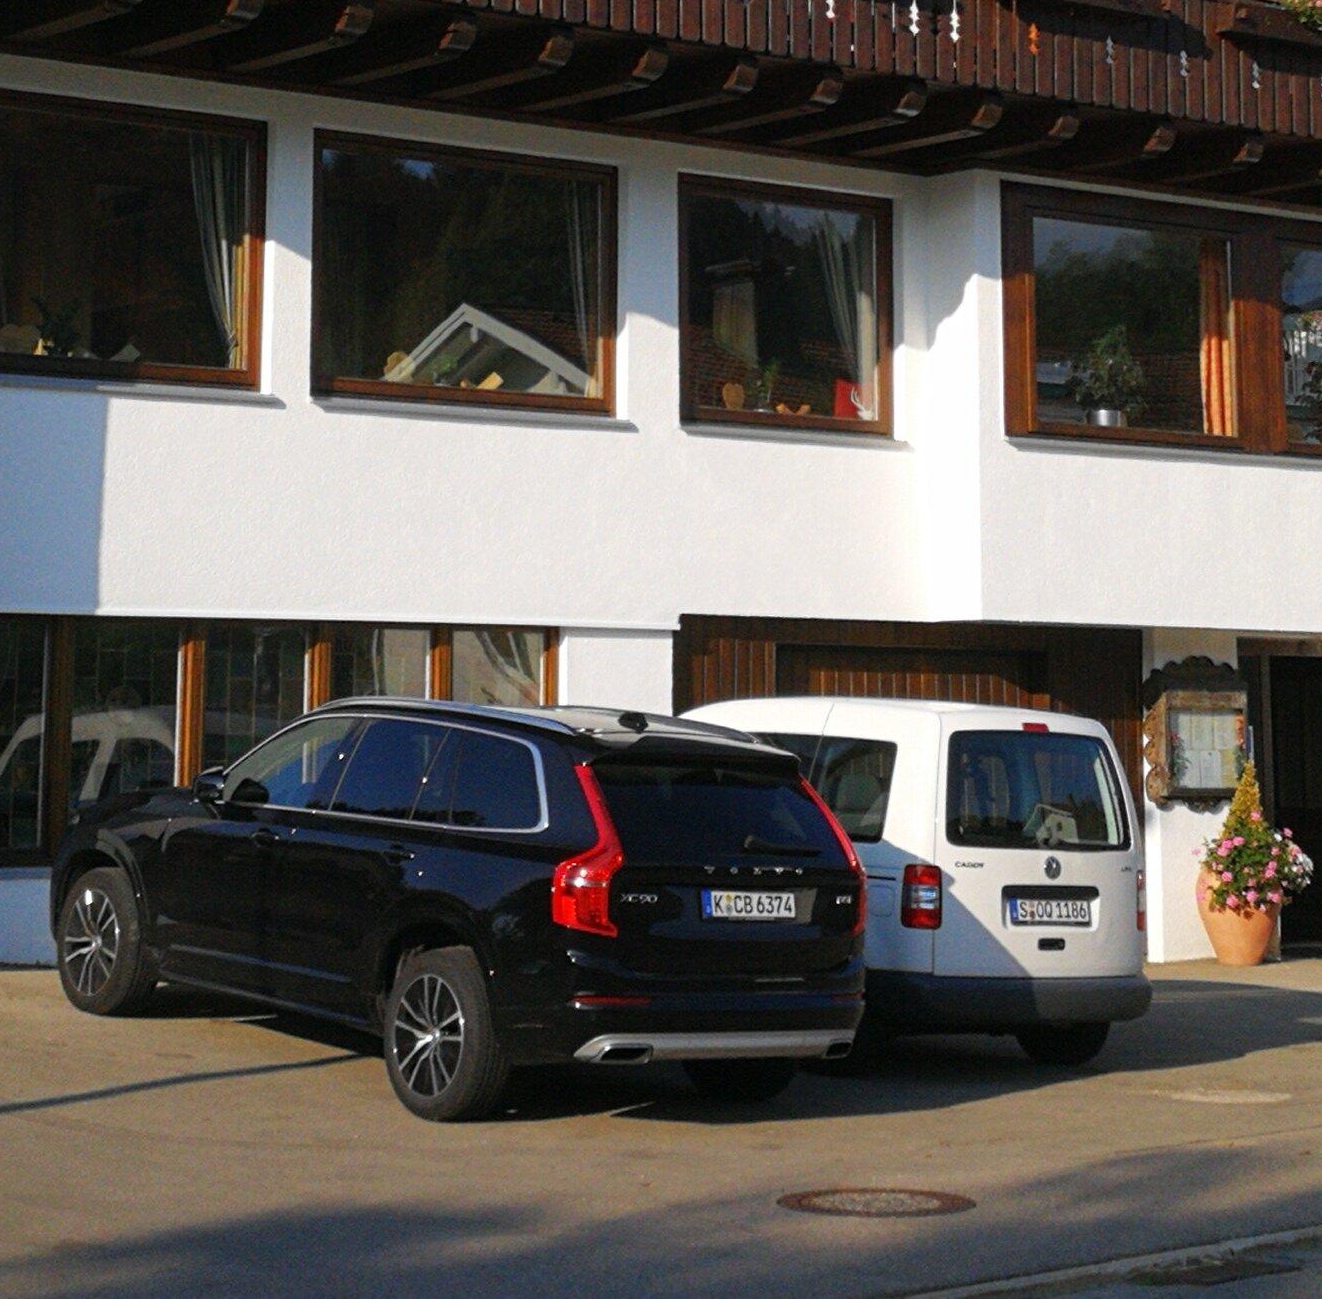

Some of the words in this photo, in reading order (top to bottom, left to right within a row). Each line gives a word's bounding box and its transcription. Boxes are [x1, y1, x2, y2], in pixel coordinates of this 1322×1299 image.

[704, 866, 803, 875] VOLVO
[621, 893, 658, 904] XC90
[714, 895, 724, 914] K
[733, 894, 754, 914] CB
[756, 894, 793, 914] 6374
[1020, 903, 1028, 918] S
[1056, 903, 1087, 919] 1186
